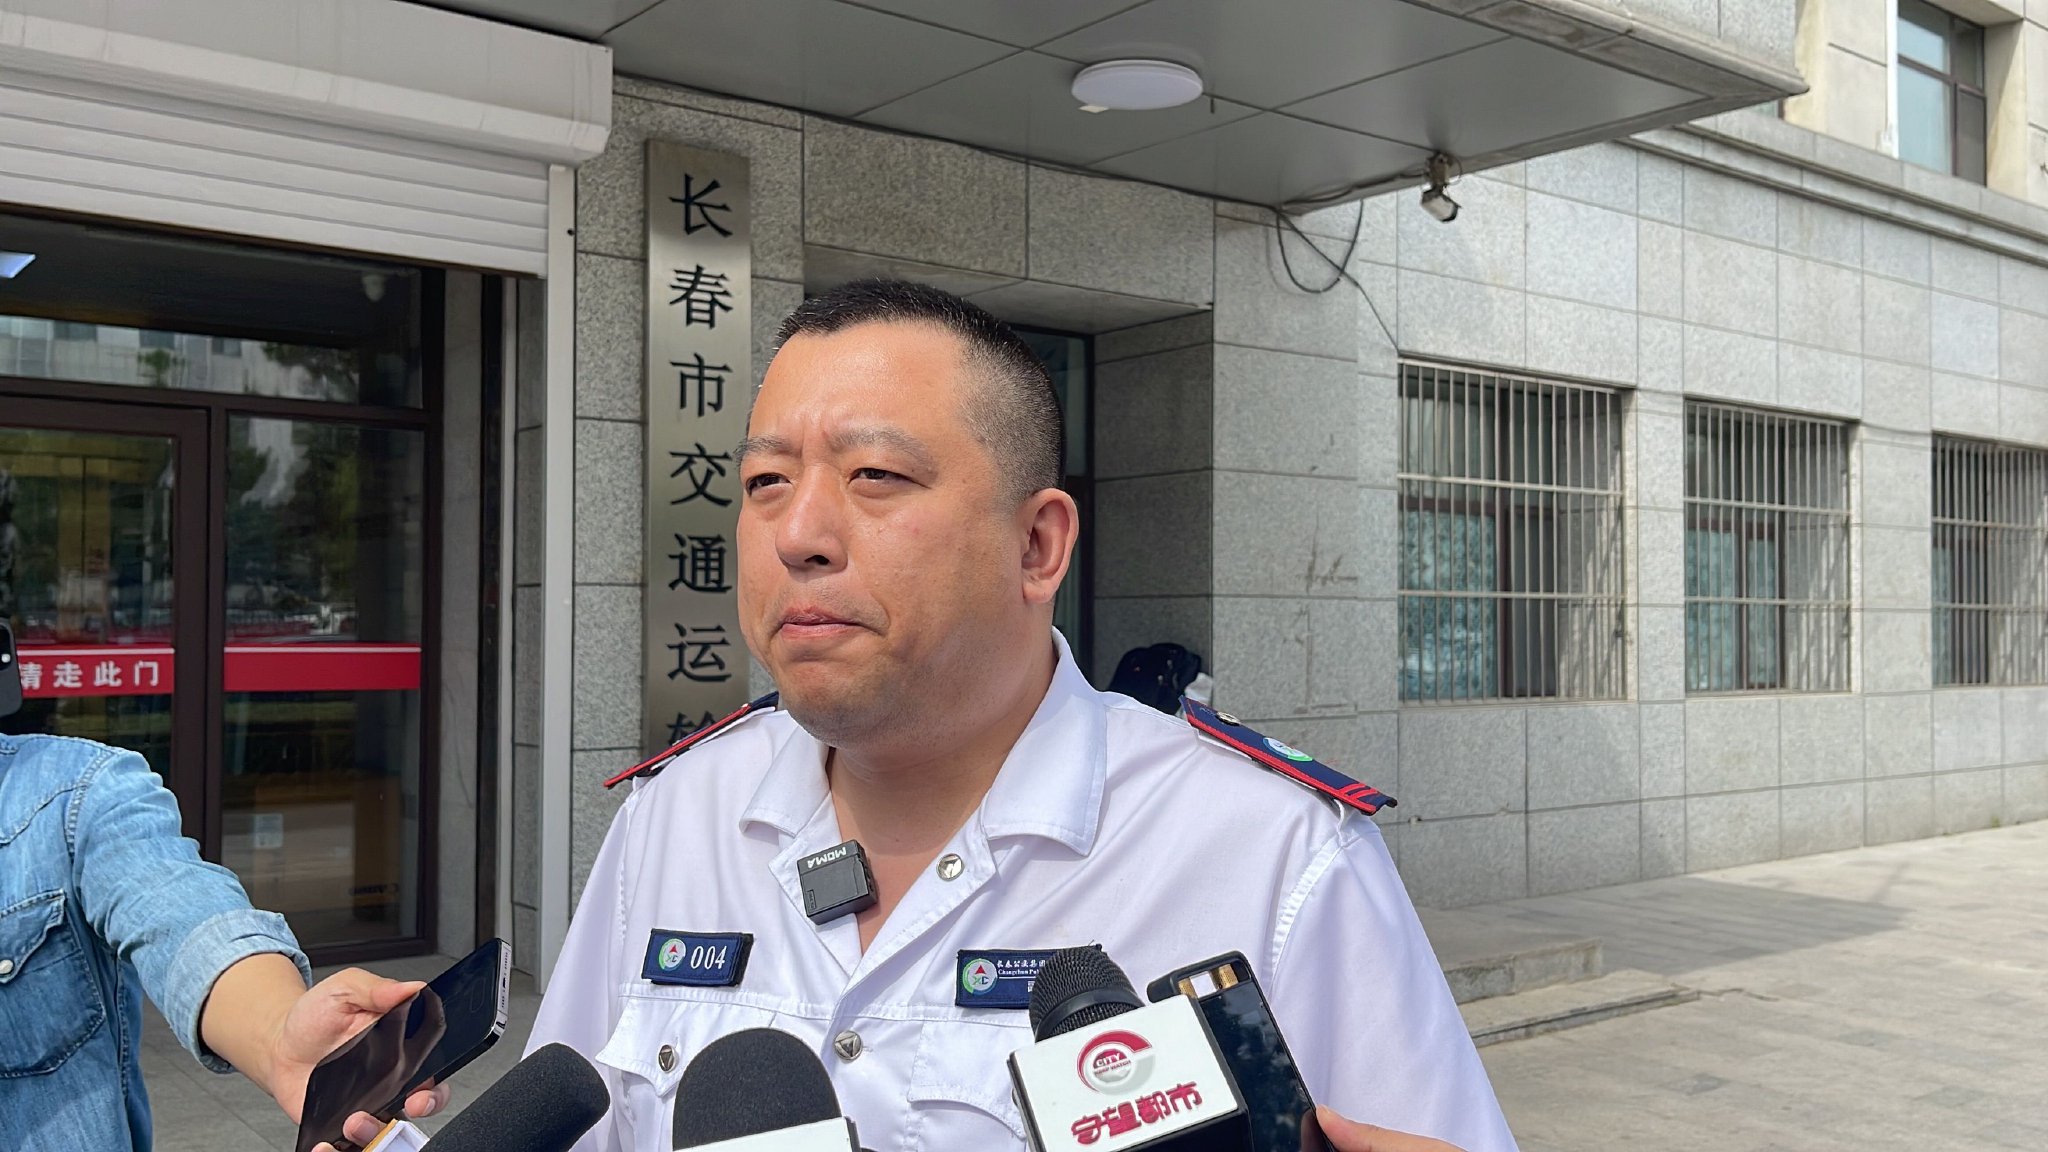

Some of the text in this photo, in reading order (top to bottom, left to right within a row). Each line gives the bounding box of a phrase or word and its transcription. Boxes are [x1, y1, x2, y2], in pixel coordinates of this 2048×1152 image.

[19, 661, 159, 690] 请走此门
[807, 846, 846, 868] MOMA
[690, 945, 727, 970] 004
[1096, 1052, 1120, 1067] CITY
[1071, 1081, 1203, 1145] 守望都市
